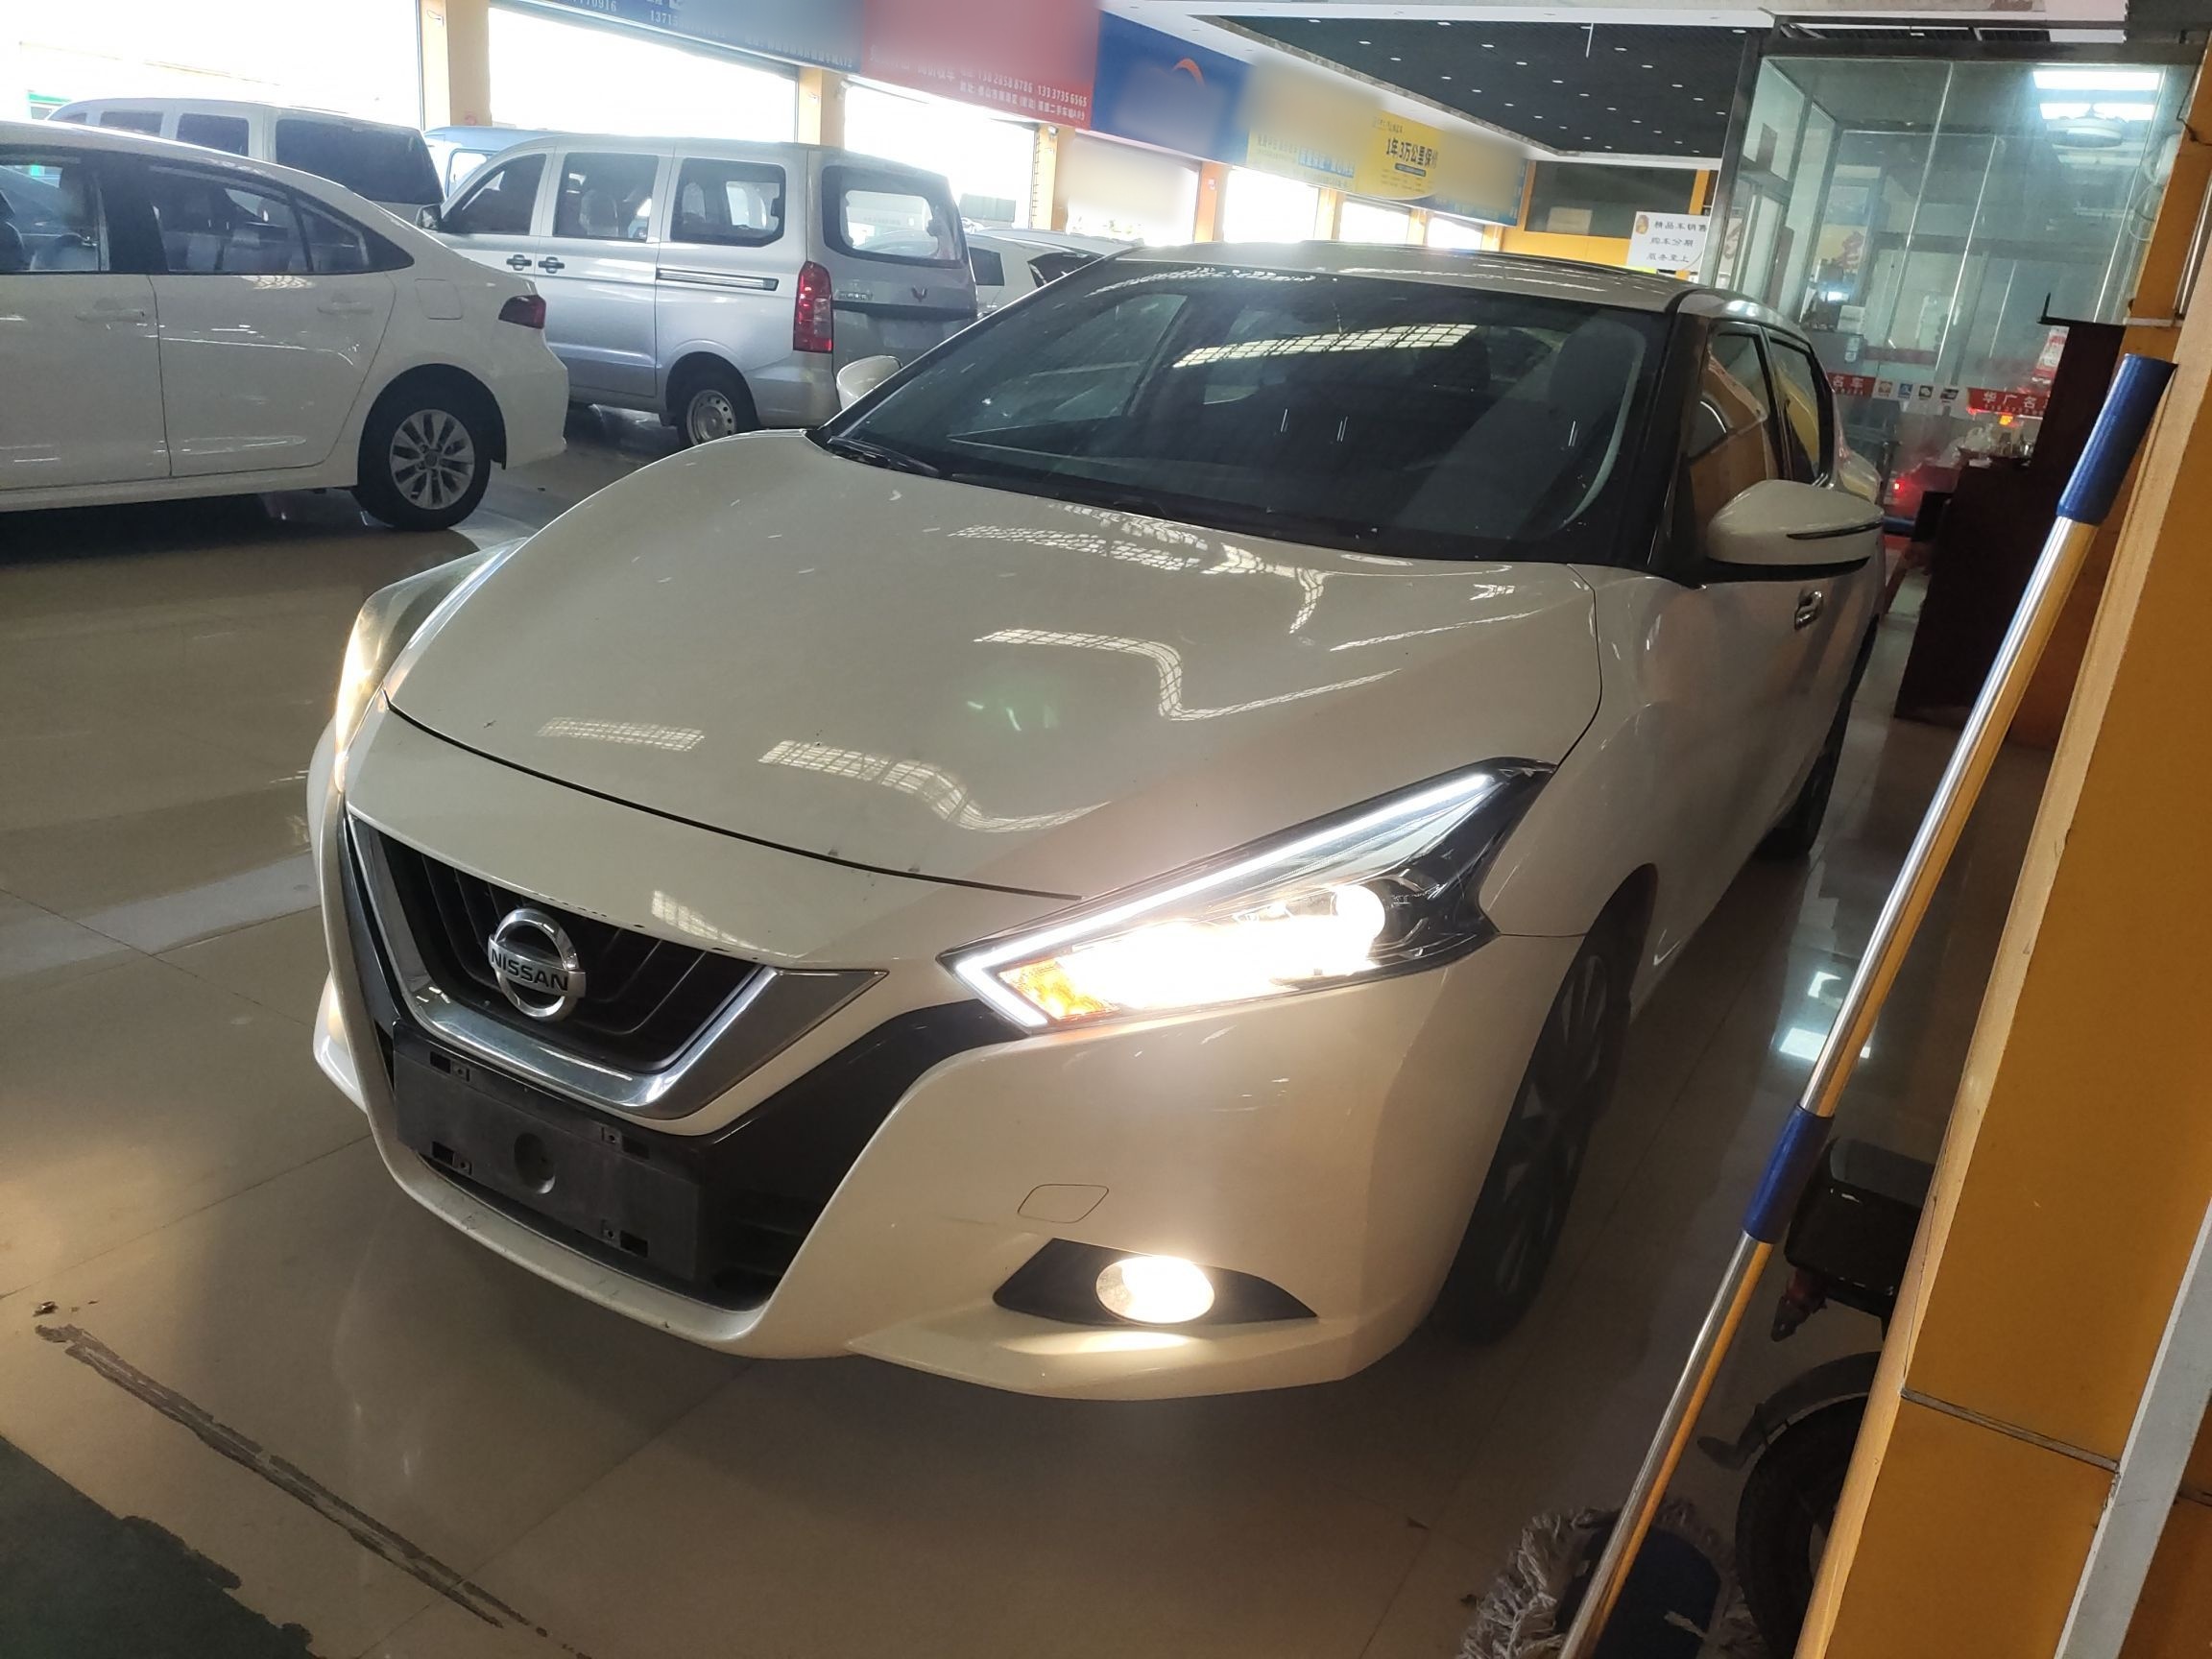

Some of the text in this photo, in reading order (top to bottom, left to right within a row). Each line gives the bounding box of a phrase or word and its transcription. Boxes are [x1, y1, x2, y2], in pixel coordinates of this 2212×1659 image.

[1654, 221, 1707, 232] 精品车销售
[1650, 237, 1694, 247] 购车分期
[1647, 252, 1690, 263] 服务至上
[1983, 391, 2049, 410] 华广名
[491, 948, 568, 991] NISSAN
